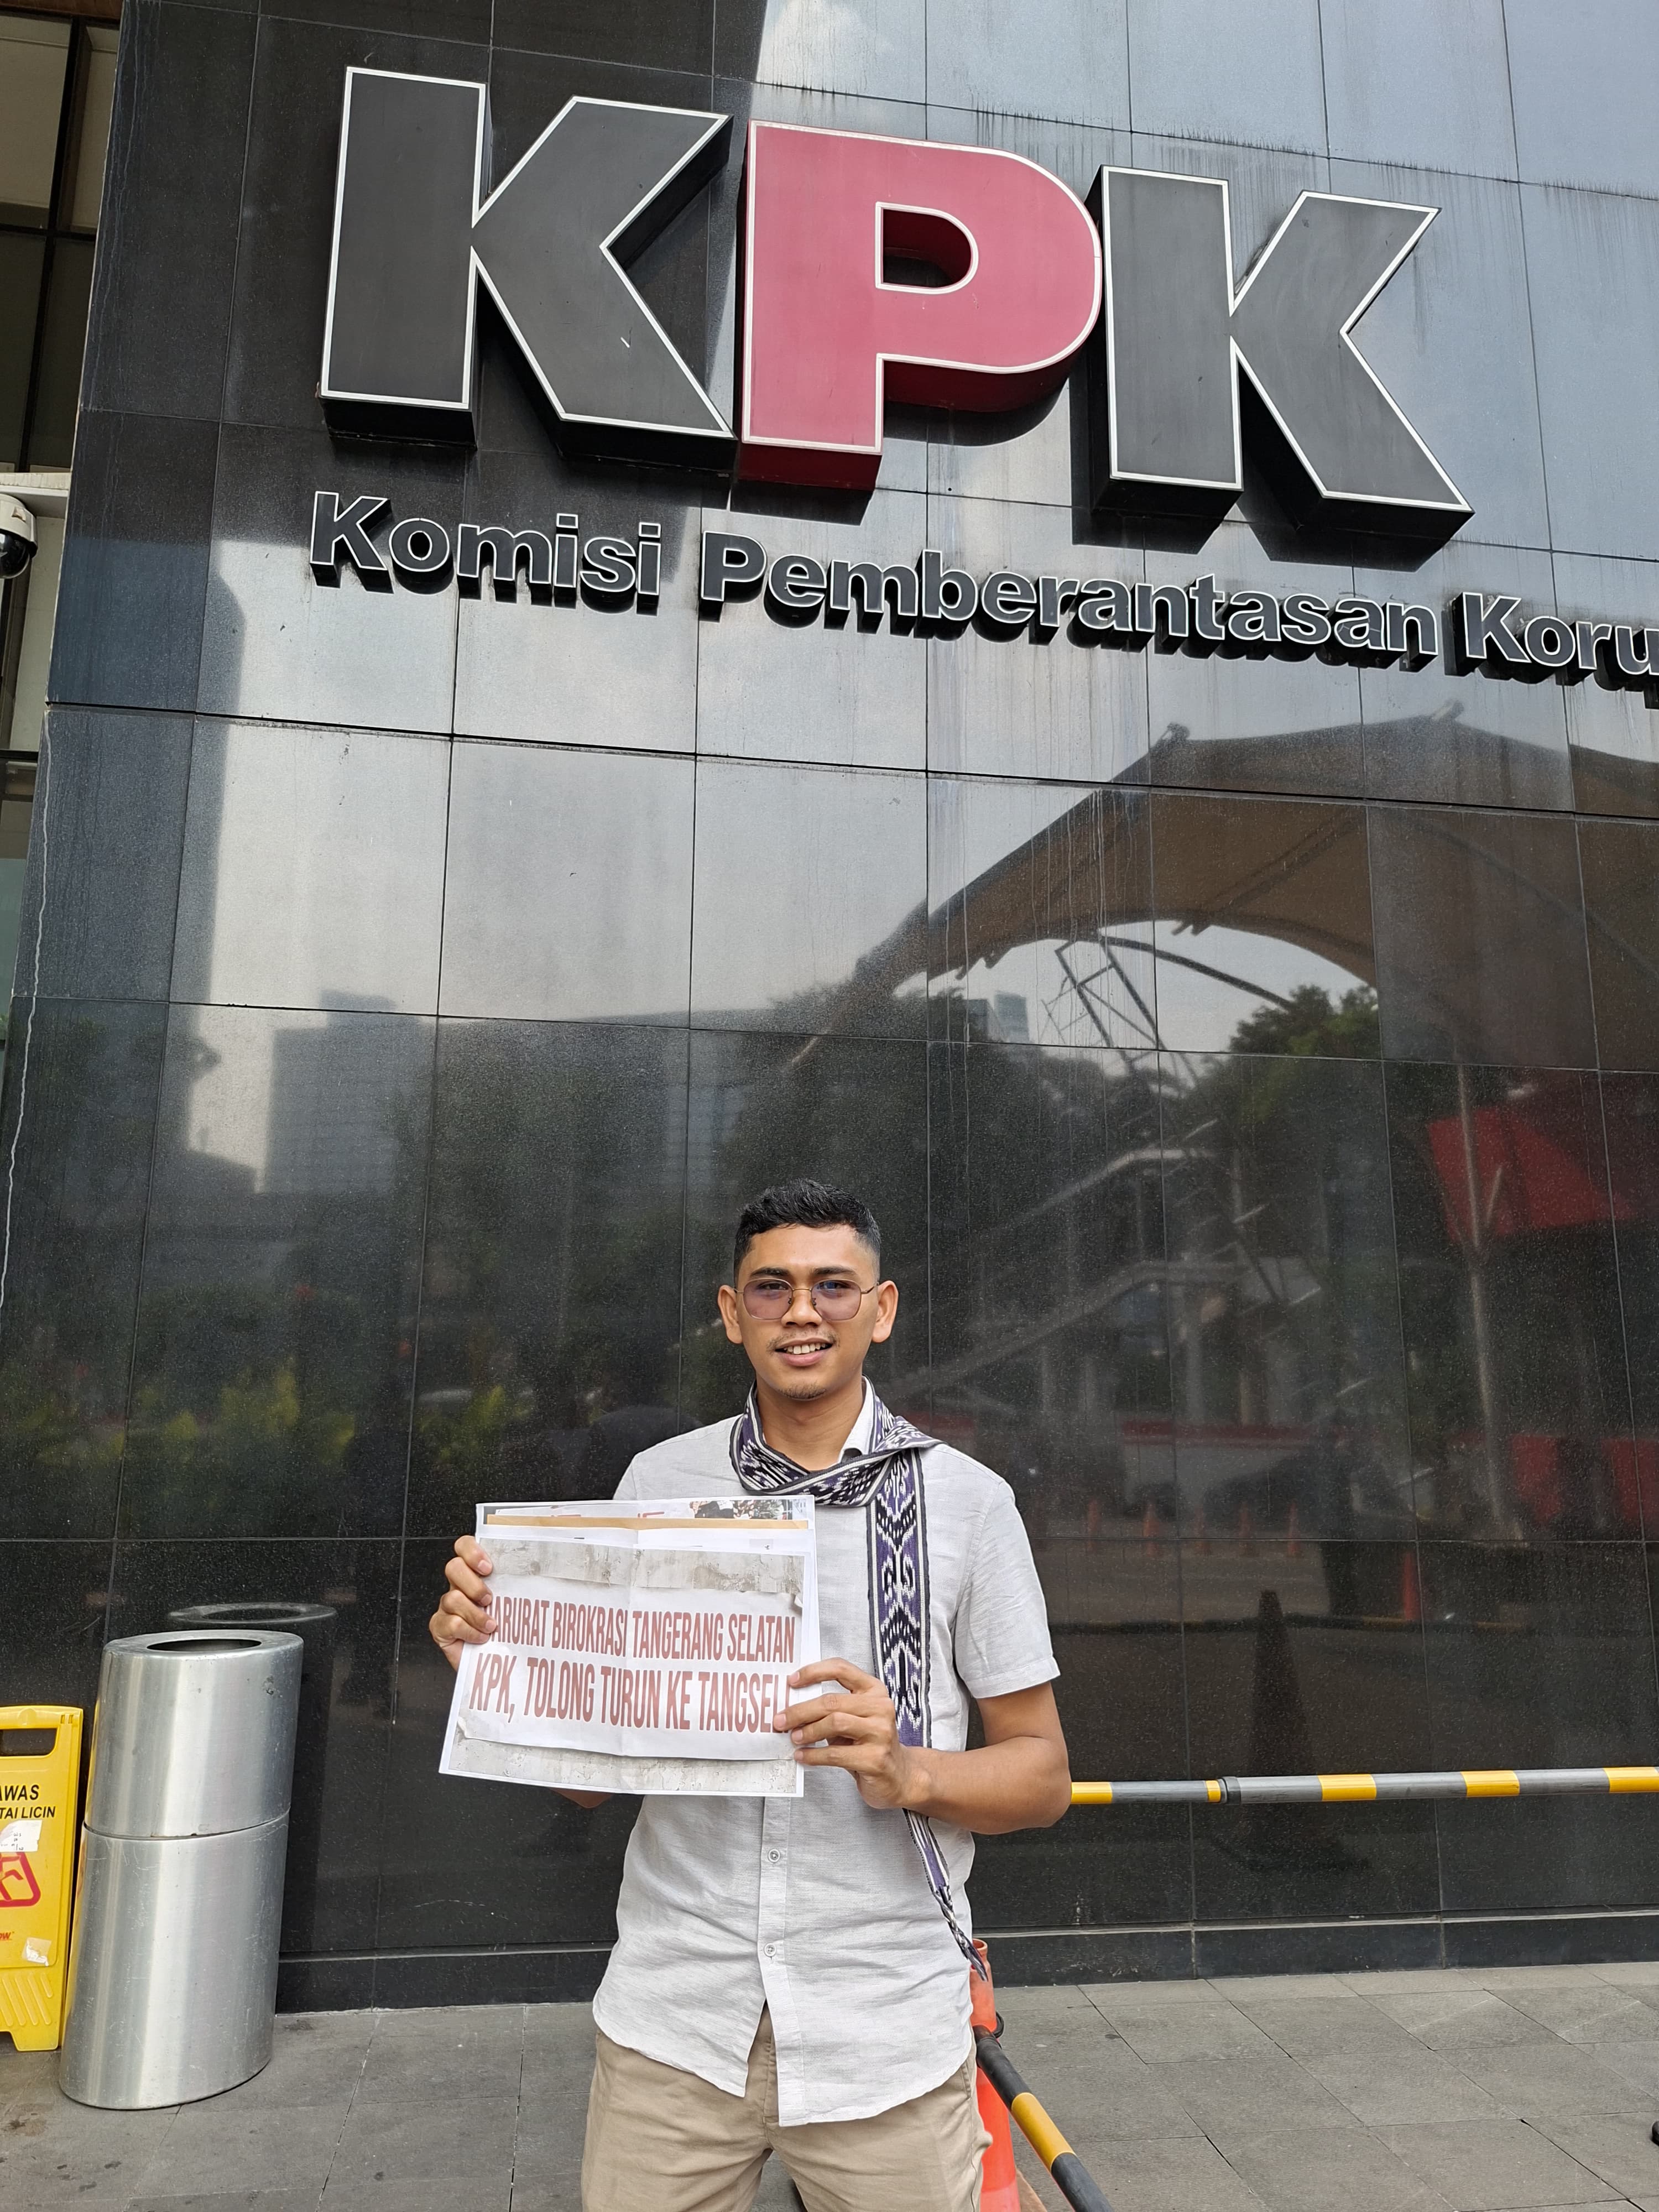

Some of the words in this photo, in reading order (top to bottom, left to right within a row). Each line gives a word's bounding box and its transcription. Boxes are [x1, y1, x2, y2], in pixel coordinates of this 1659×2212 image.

[321, 66, 1471, 513] KPK
[310, 491, 661, 597] Komisi
[700, 530, 1438, 656] Pemberantasan
[551, 1601, 628, 1657] BIROKRASI
[632, 1610, 724, 1661] TANGERANG
[727, 1613, 795, 1663] SELATAN
[469, 1653, 517, 1723] KPK,
[524, 1657, 596, 1722] TOLONG
[600, 1666, 661, 1729] TURUN
[665, 1671, 692, 1730] KE
[0, 1785, 39, 1801] WAS
[21, 1806, 56, 1819] LICIN
